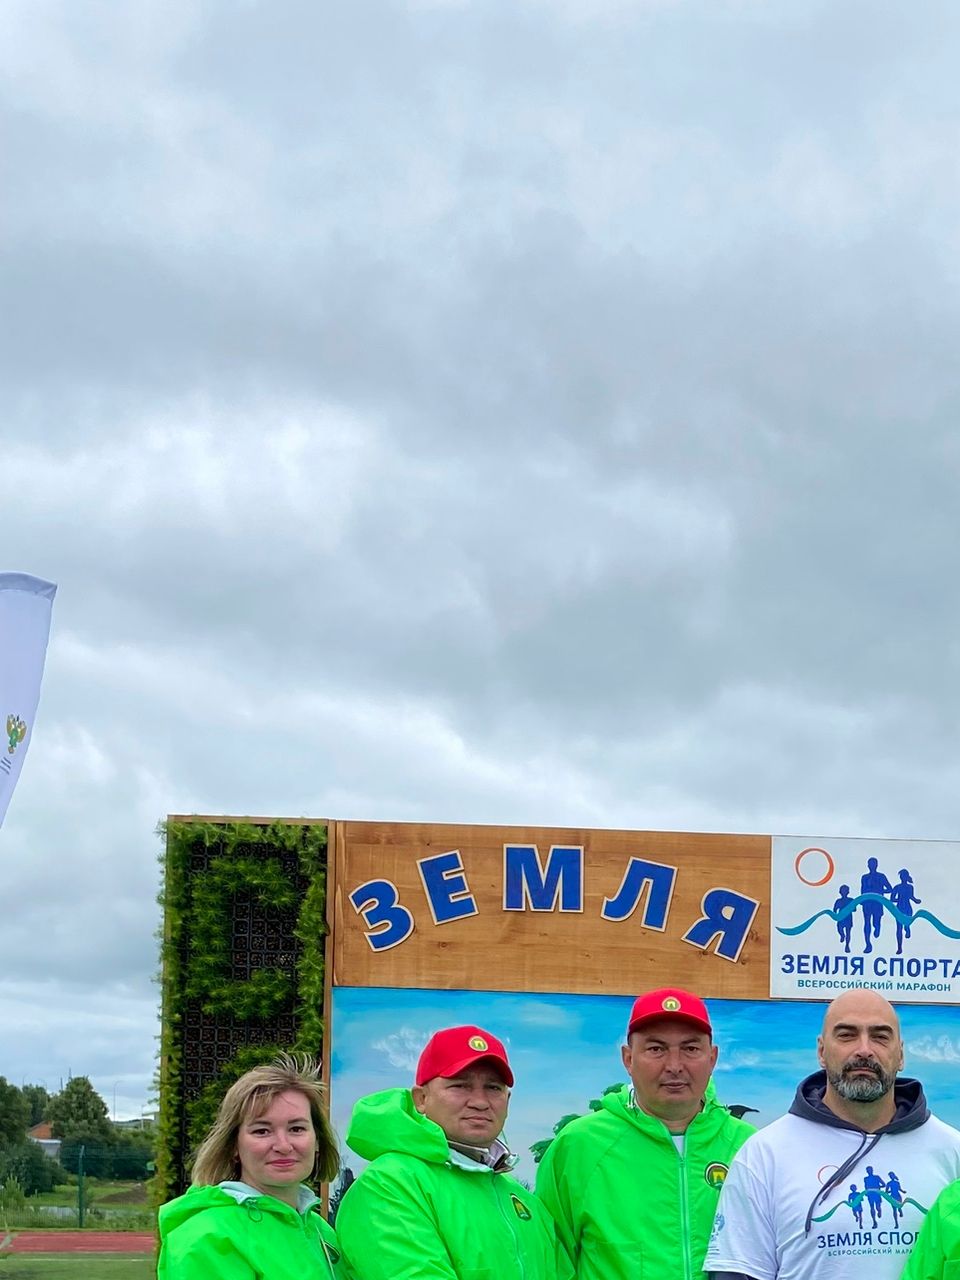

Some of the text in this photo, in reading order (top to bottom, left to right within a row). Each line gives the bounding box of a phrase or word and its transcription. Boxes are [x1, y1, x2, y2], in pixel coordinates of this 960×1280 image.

[348, 843, 761, 963] ЗЕМЛЯ
[781, 954, 865, 976] ЗЕМЛЯ
[797, 979, 951, 992] ВСЕРОССИЙСКИЙ МАРАФОН
[817, 1231, 919, 1249] ЗЕМЛЯ СПО
